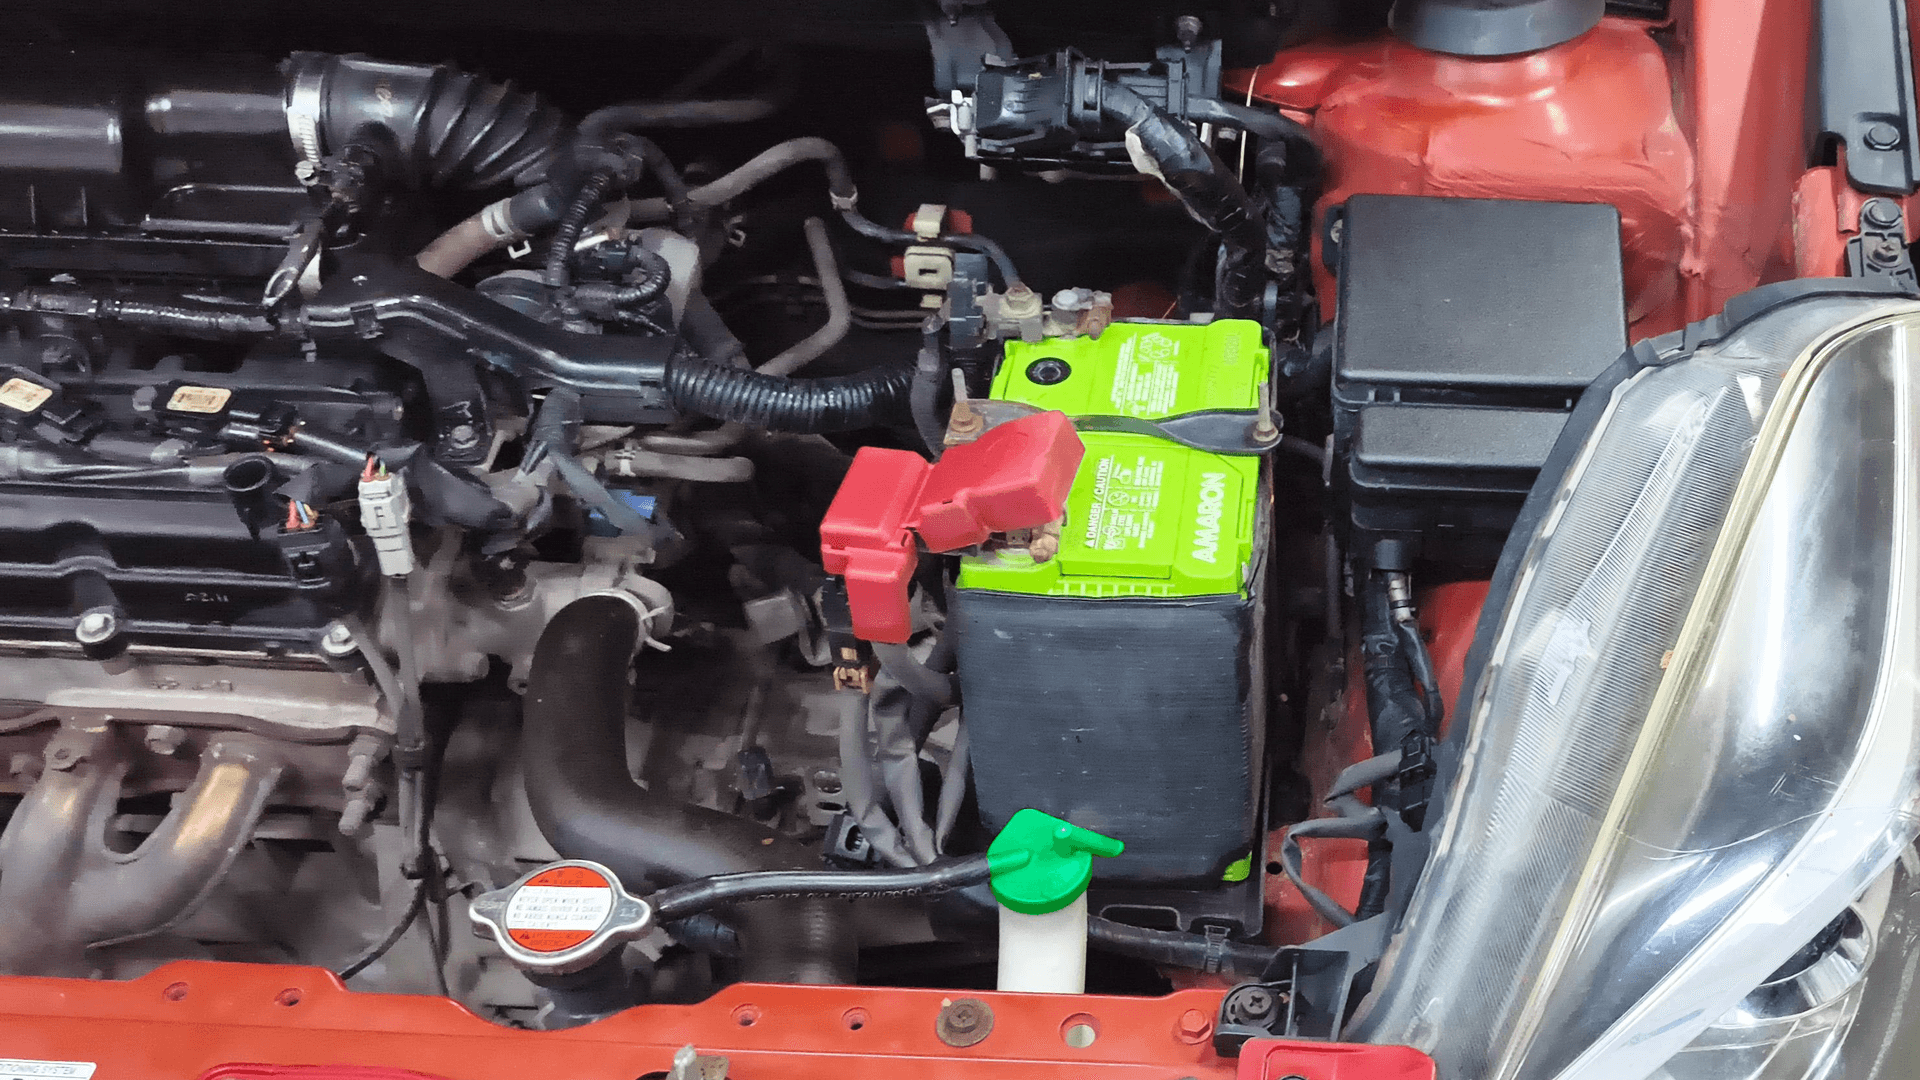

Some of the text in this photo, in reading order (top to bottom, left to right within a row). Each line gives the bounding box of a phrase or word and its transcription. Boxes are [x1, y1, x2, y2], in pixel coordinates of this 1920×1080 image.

[1086, 502, 1102, 539] DANGER
[1094, 457, 1110, 496] CAUTION
[1191, 472, 1227, 564] AMARON
